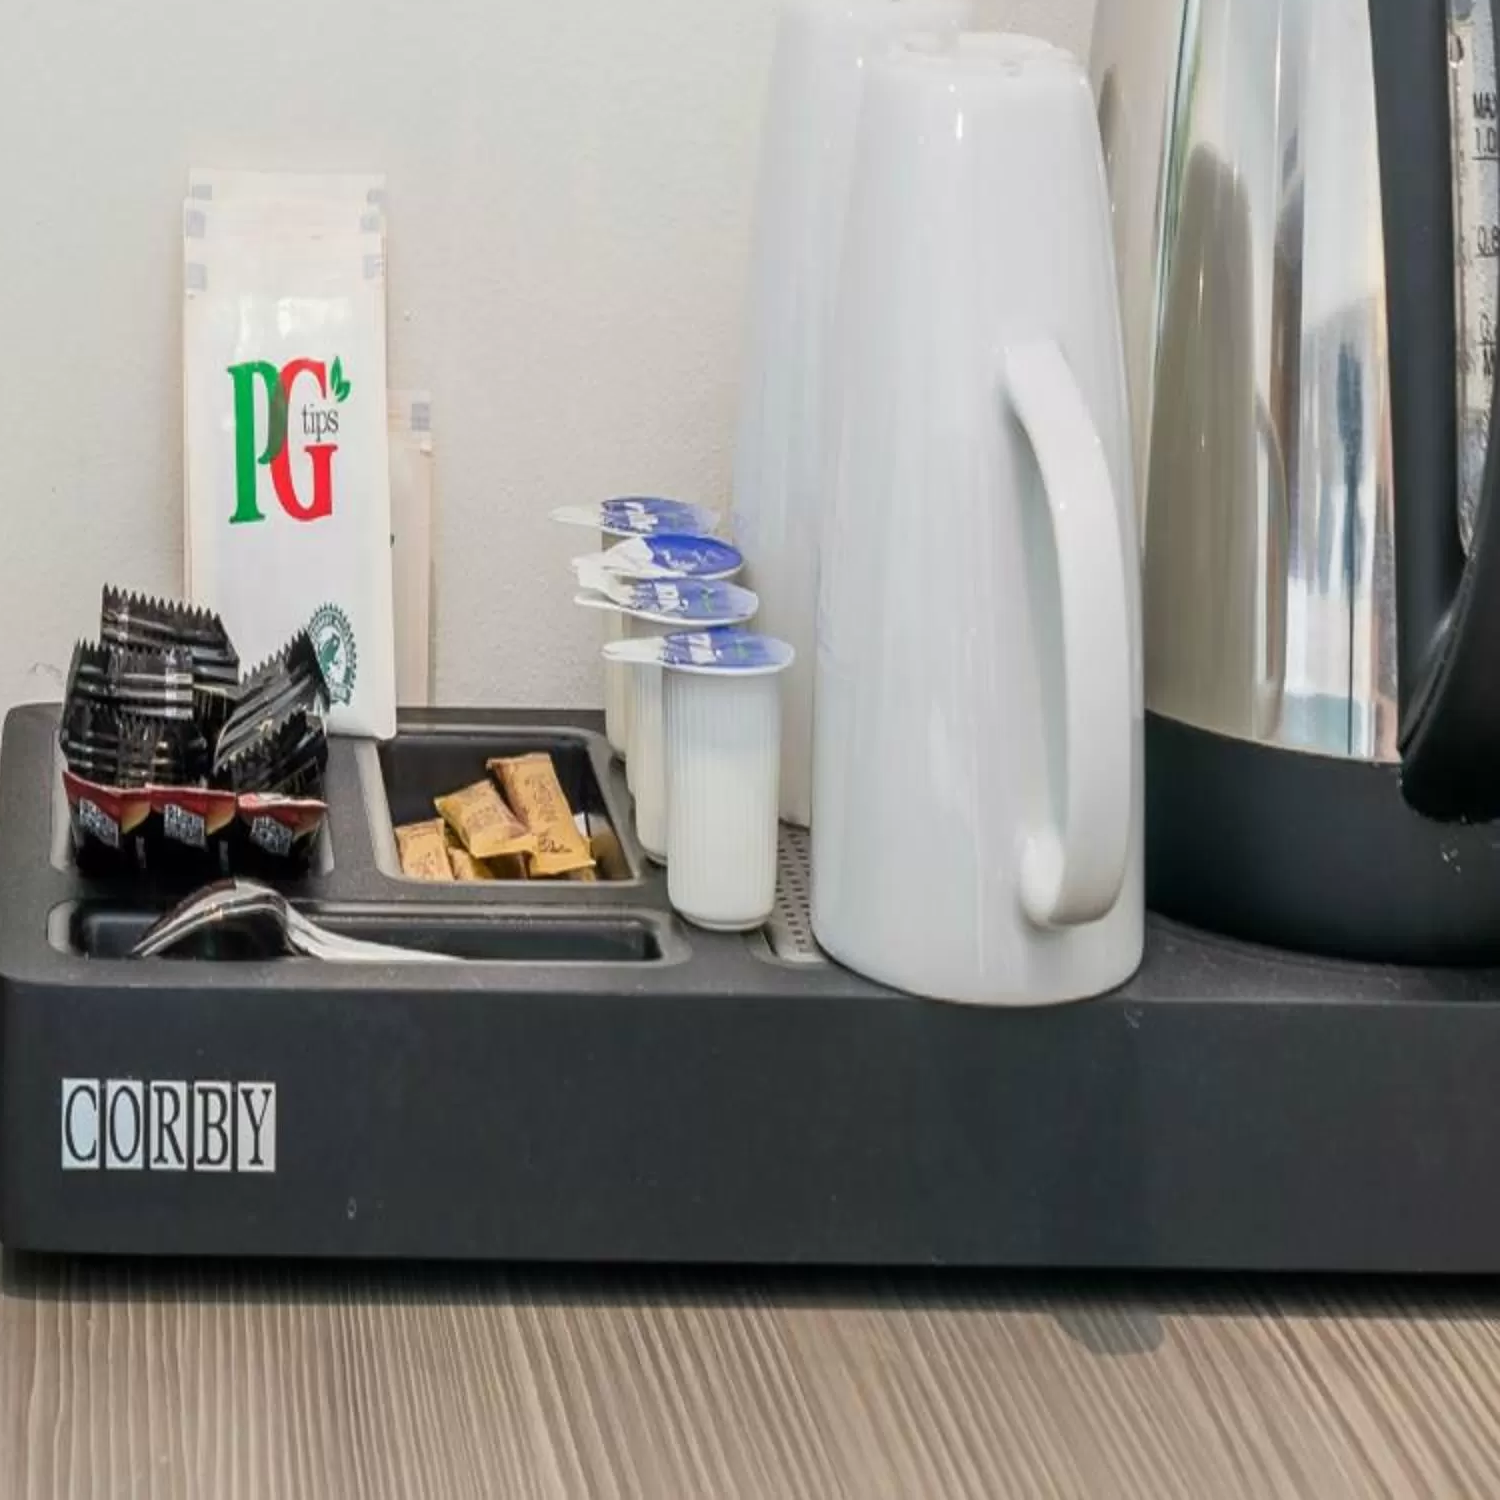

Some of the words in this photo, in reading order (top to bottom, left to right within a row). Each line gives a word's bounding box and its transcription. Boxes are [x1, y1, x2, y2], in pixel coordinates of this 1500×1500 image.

[227, 357, 338, 524] PG
[302, 403, 339, 442] tips
[64, 1083, 273, 1167] CORBY
